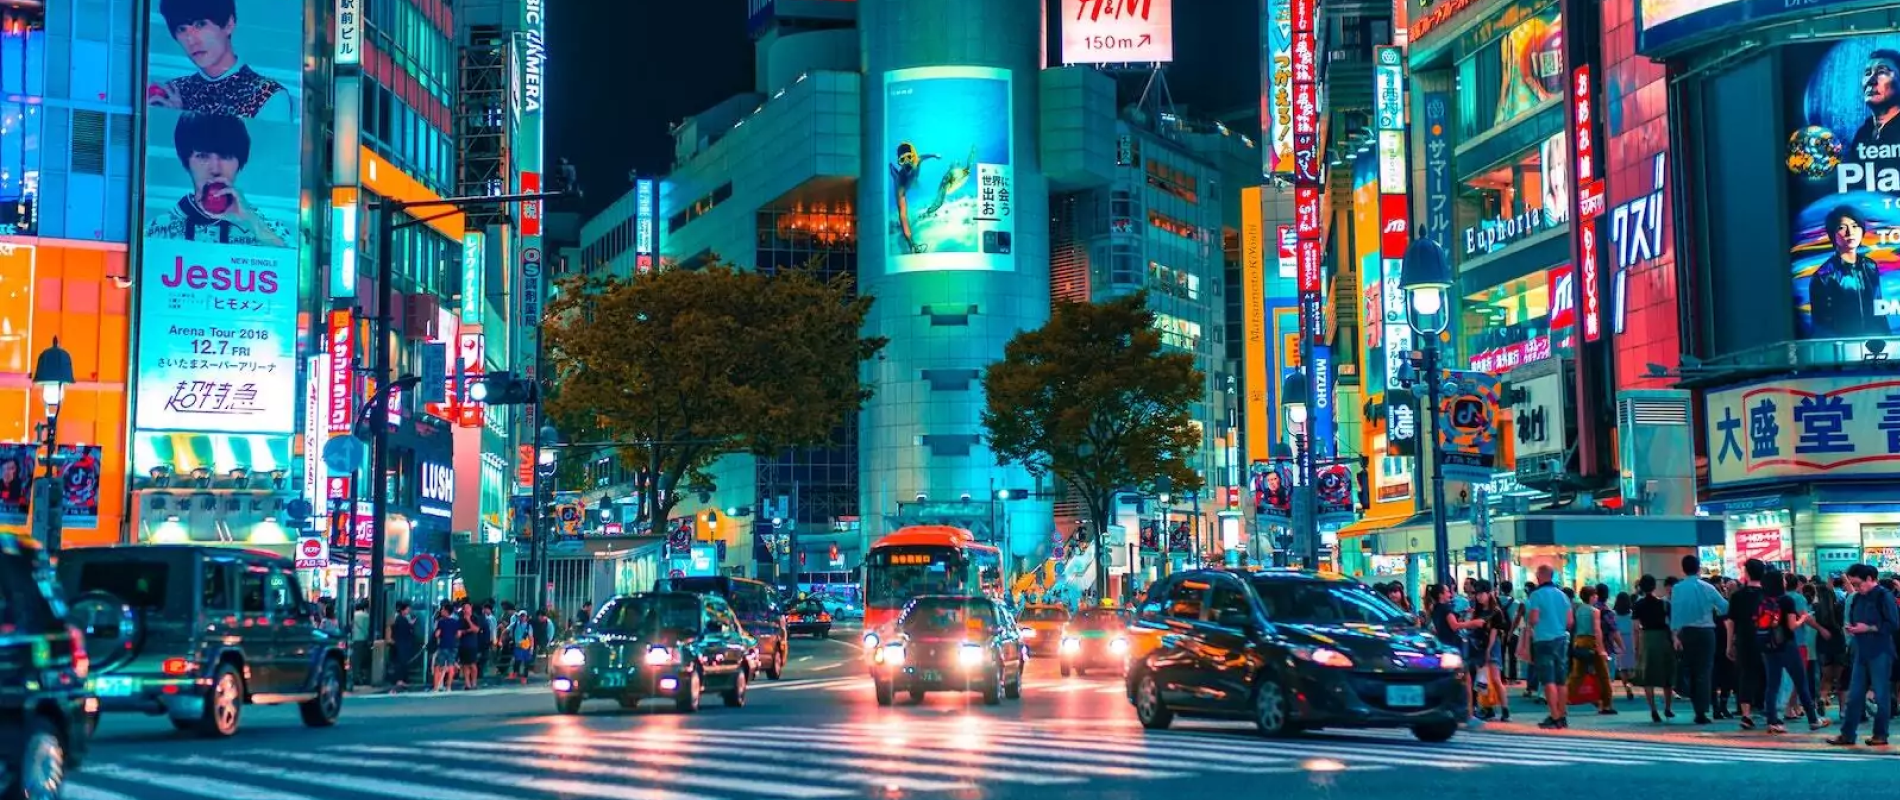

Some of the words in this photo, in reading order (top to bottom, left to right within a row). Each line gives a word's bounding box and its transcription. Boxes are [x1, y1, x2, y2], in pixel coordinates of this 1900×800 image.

[341, 0, 352, 54] 駅前ビル
[527, 0, 539, 24] BIC
[1084, 36, 1132, 50] 150m
[526, 29, 547, 112] CAMERA
[1429, 139, 1449, 258] サマーフルー
[1384, 219, 1406, 233] JTB
[1466, 203, 1540, 254] Euphoria
[161, 256, 278, 294] Jesus
[231, 257, 249, 267] NEW
[251, 259, 278, 268] SINGLE
[169, 325, 205, 337] Arena
[209, 327, 235, 339] Tour
[240, 329, 269, 341] 2018
[191, 339, 229, 355] 12.7
[232, 346, 251, 357] FRI
[158, 357, 277, 373] さいたまスーパーアリーナ
[164, 379, 266, 414] 超特急
[1316, 358, 1327, 408] MIZUHO
[1394, 404, 1414, 440] HUB
[421, 461, 454, 503] LUSH
